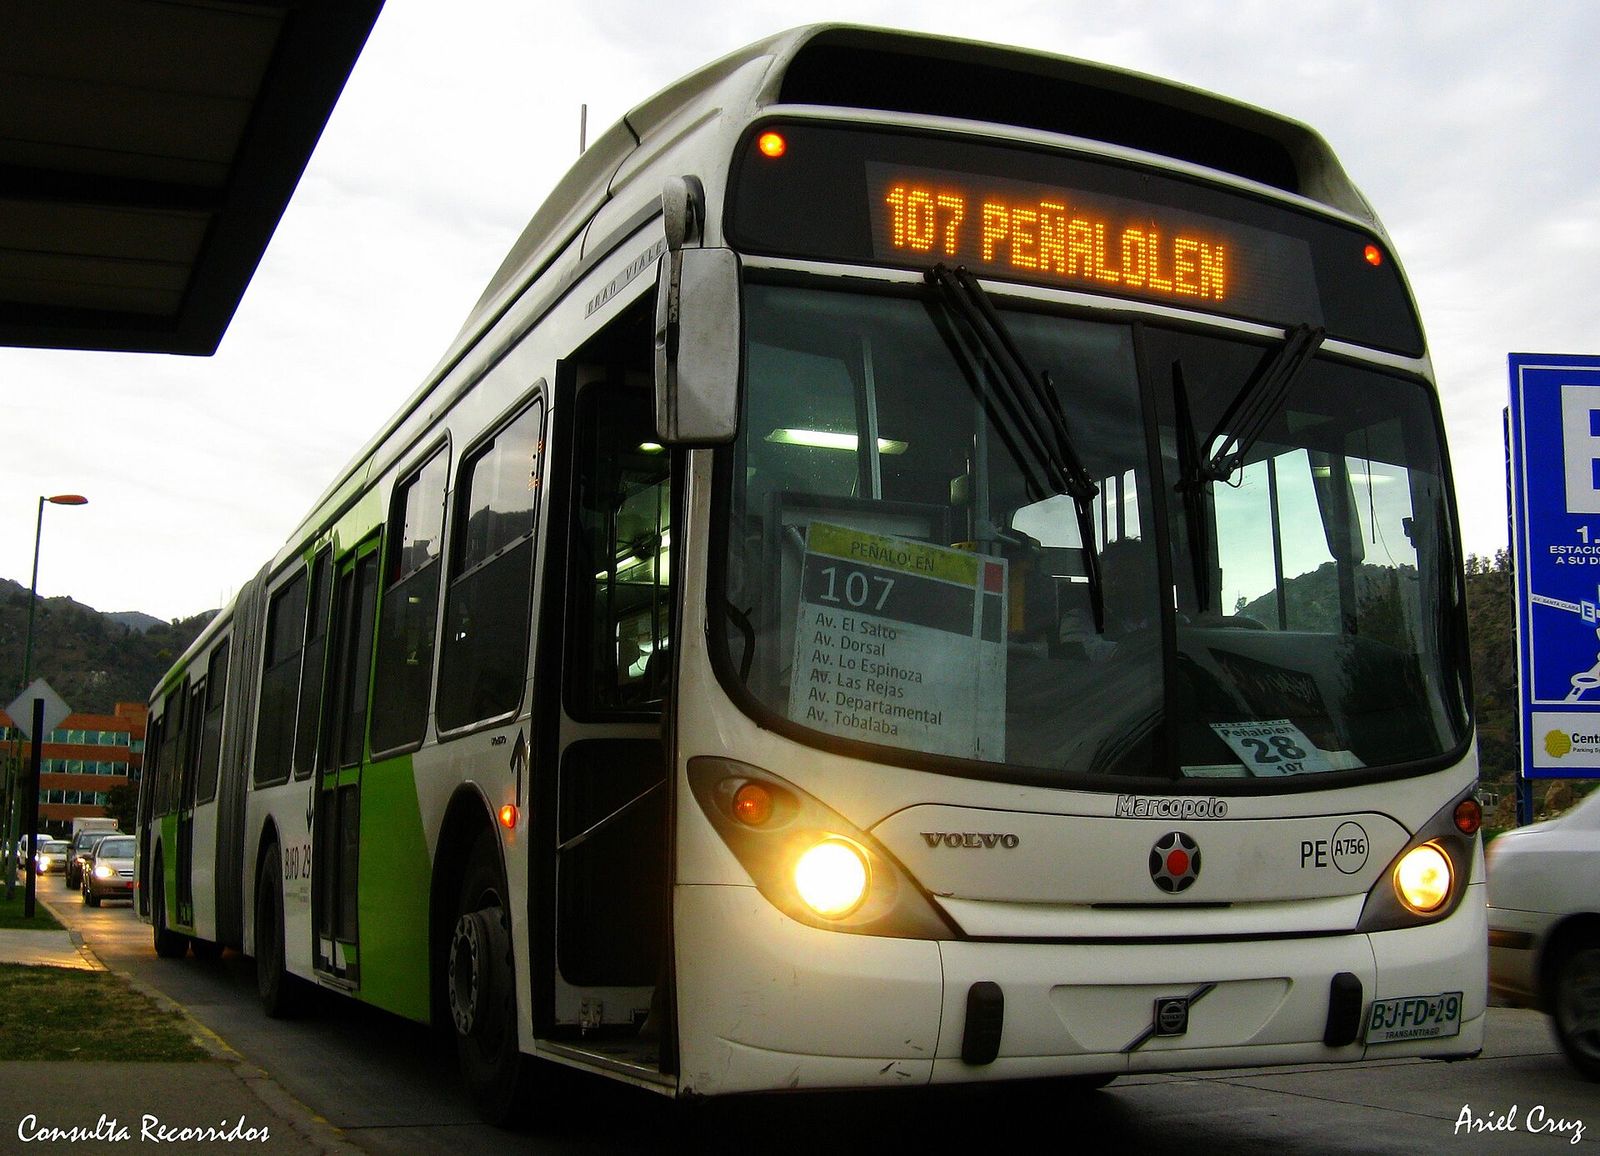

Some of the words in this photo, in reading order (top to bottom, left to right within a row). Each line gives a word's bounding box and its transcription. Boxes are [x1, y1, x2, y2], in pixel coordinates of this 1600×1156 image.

[886, 187, 963, 255] 107
[983, 201, 1225, 300] PEÑALOLEN
[1555, 556, 1565, 564] A
[1568, 556, 1586, 565] SU
[820, 567, 896, 611] 107
[1584, 605, 1593, 618] E
[815, 613, 837, 629] Av.
[842, 617, 855, 632] El
[860, 621, 897, 640] Salto
[813, 631, 835, 648] Av.
[841, 635, 886, 657] Dorsal
[811, 649, 833, 666] Av.
[839, 654, 856, 670] Lo
[861, 658, 923, 684] Espinoza
[810, 668, 832, 685] Av.
[837, 672, 861, 690] Las
[866, 678, 904, 698] Rejas
[808, 686, 830, 704] Av.
[835, 691, 942, 726] Departamental
[806, 706, 828, 723] Av.
[834, 710, 898, 737] Tobalaba
[1241, 735, 1307, 764] 28
[1276, 762, 1305, 775] 107
[1115, 794, 1229, 820] Marcopolo
[920, 831, 1020, 849] VOLVO
[1300, 840, 1328, 869] PE
[1334, 837, 1366, 857] A756
[1385, 1027, 1440, 1040] TRANSANTIAGO
